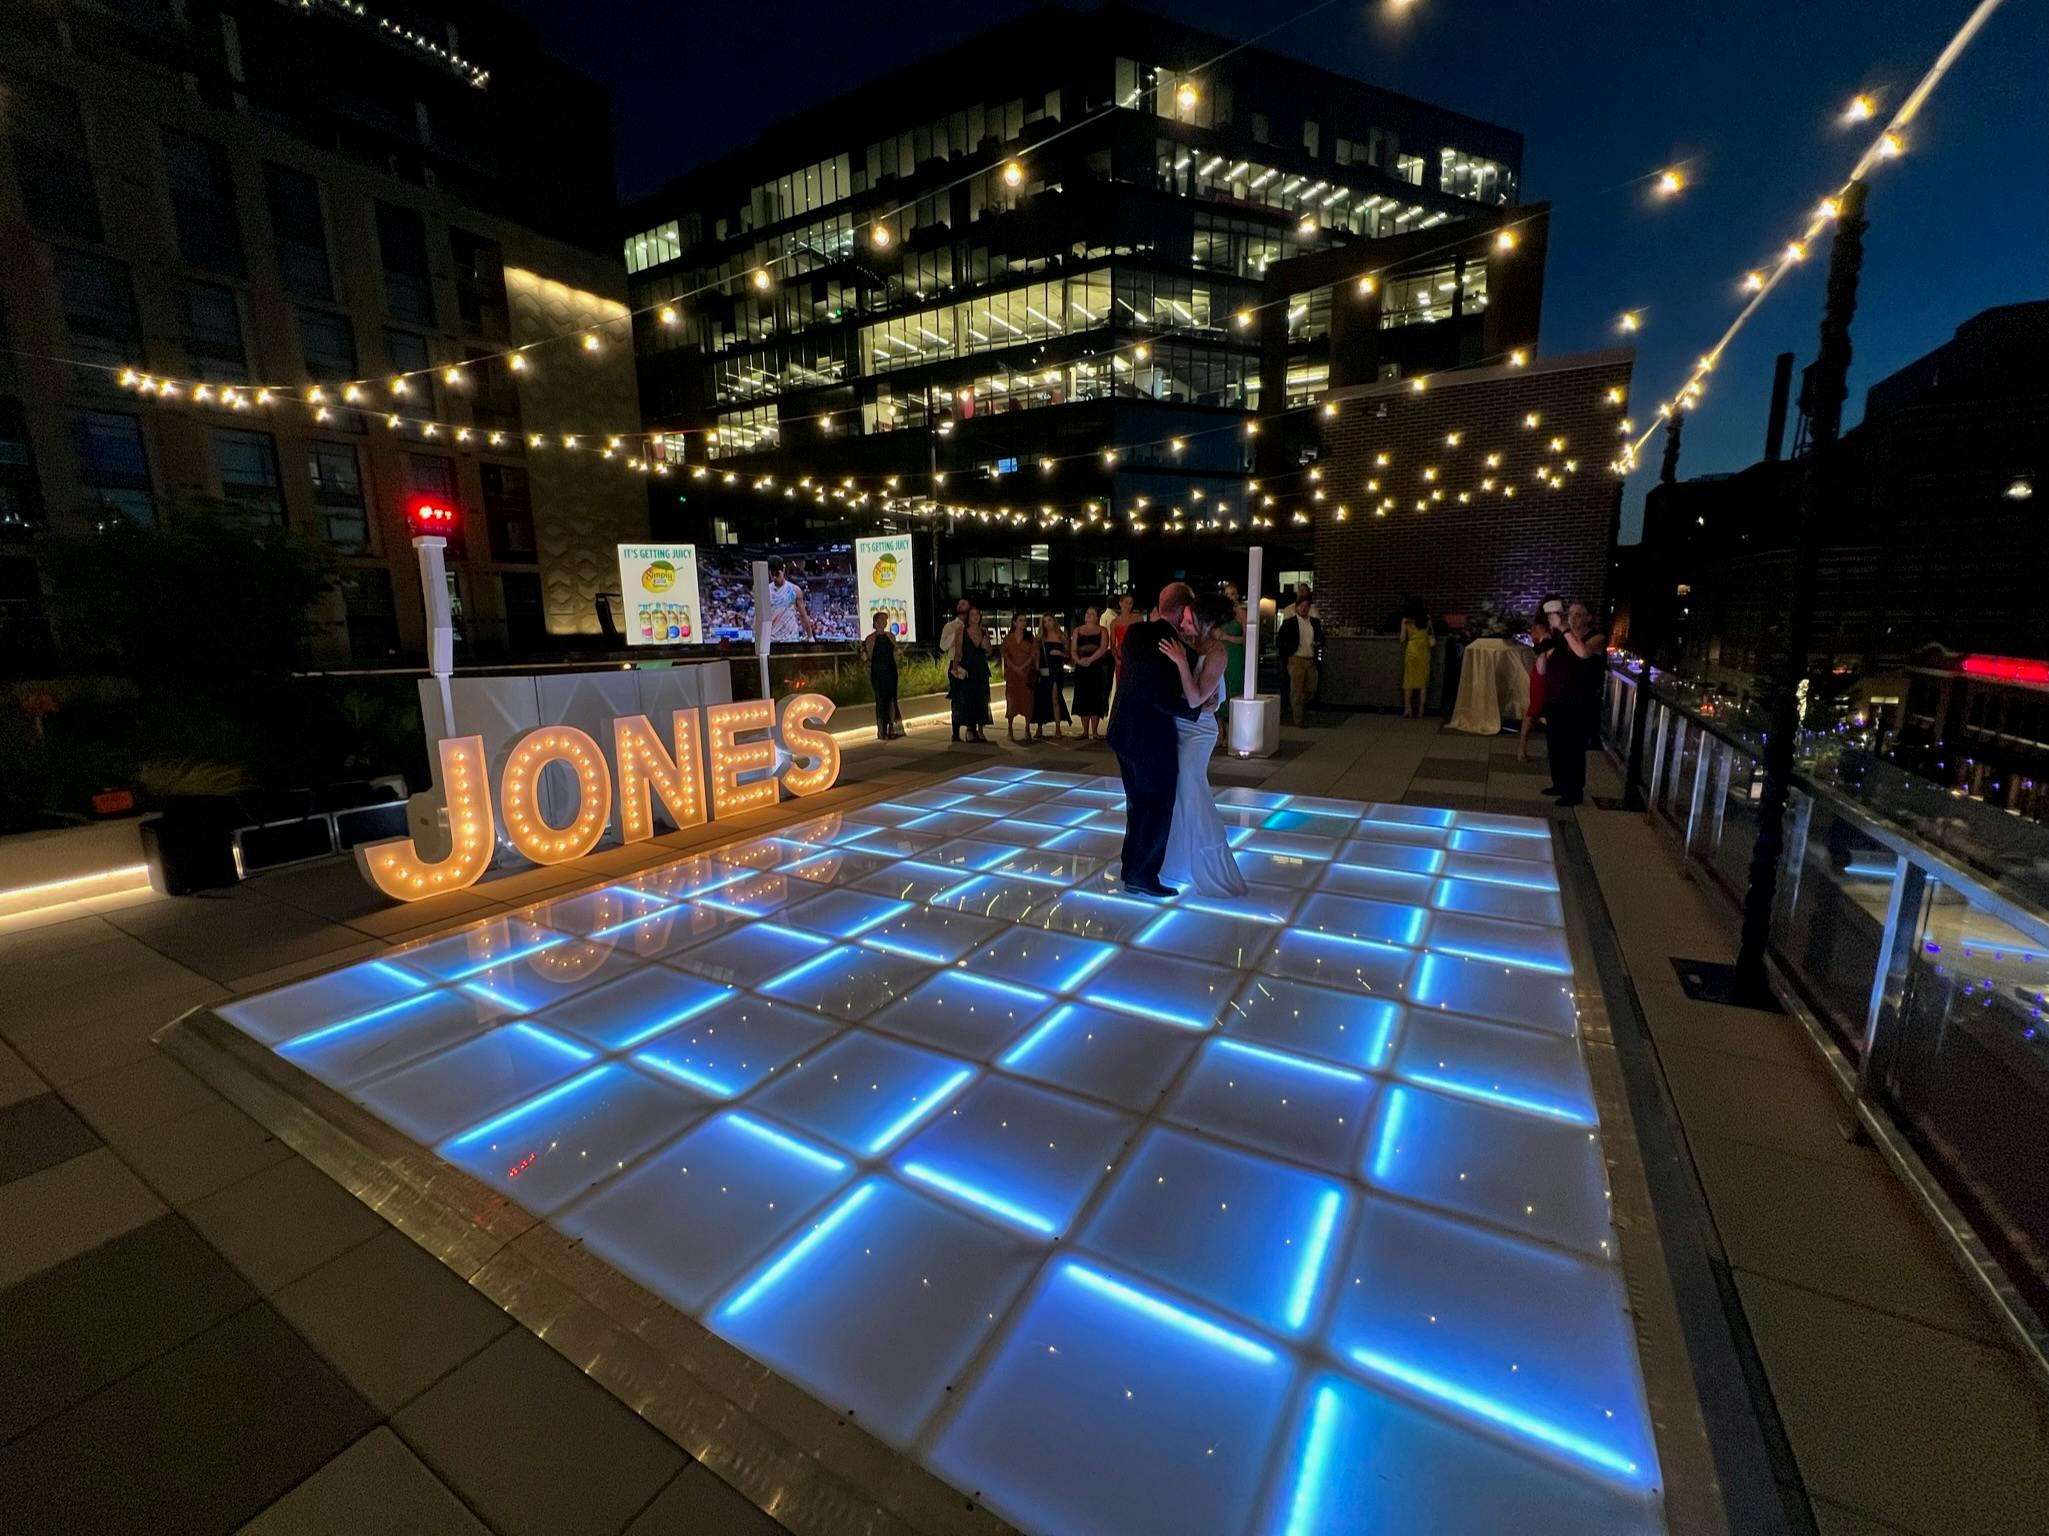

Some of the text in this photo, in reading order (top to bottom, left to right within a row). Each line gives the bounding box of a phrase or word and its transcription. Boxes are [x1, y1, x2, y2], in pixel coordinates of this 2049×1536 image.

[860, 543, 870, 552] IT'S
[872, 541, 894, 552] GETTING
[895, 539, 909, 551] JUICY
[623, 549, 692, 558] IT'S GETTING JUICY
[645, 569, 672, 581] Simply
[364, 693, 841, 902] JONES
